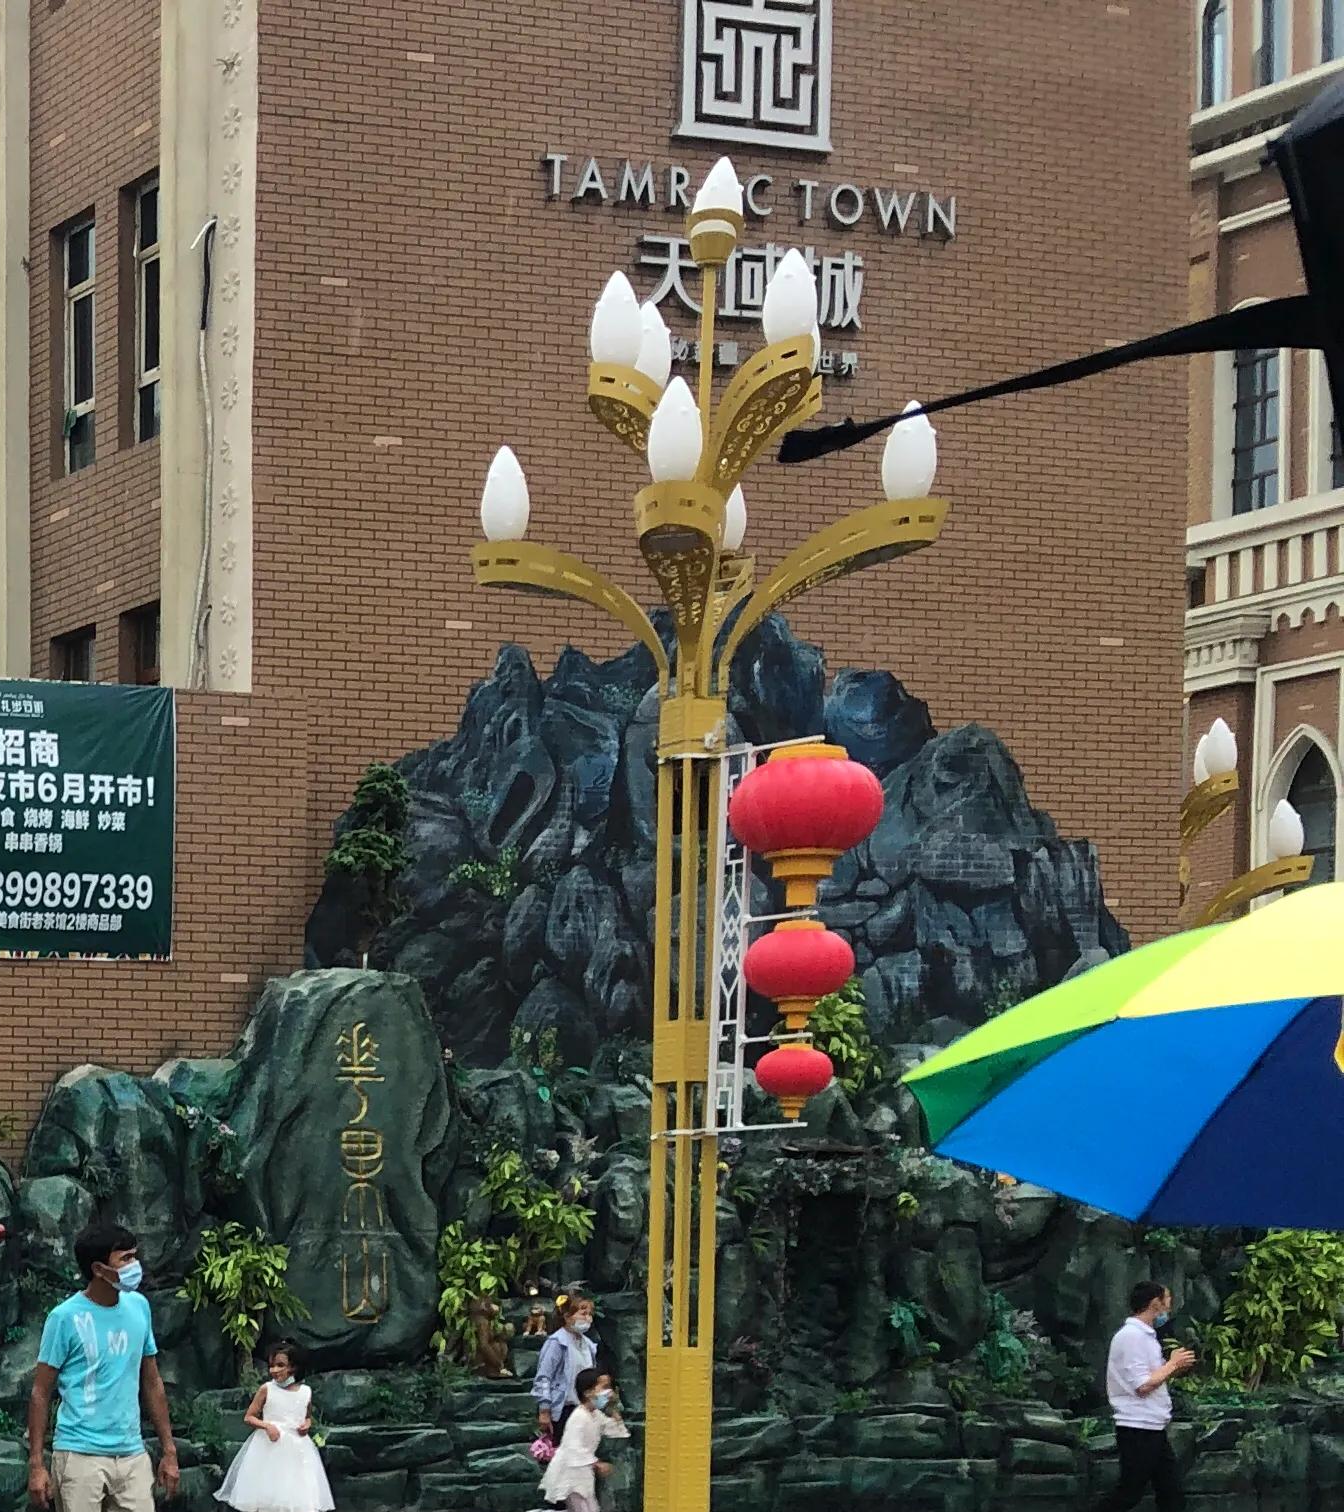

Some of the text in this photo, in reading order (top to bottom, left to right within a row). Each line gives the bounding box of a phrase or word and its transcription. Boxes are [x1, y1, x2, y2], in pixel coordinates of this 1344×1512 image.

[542, 152, 957, 239] TAMRC TOWN
[23, 807, 53, 829] 烧烤
[60, 809, 90, 831] 海鲜
[97, 810, 127, 832] 炒菜
[4, 831, 63, 854] 串串香锅
